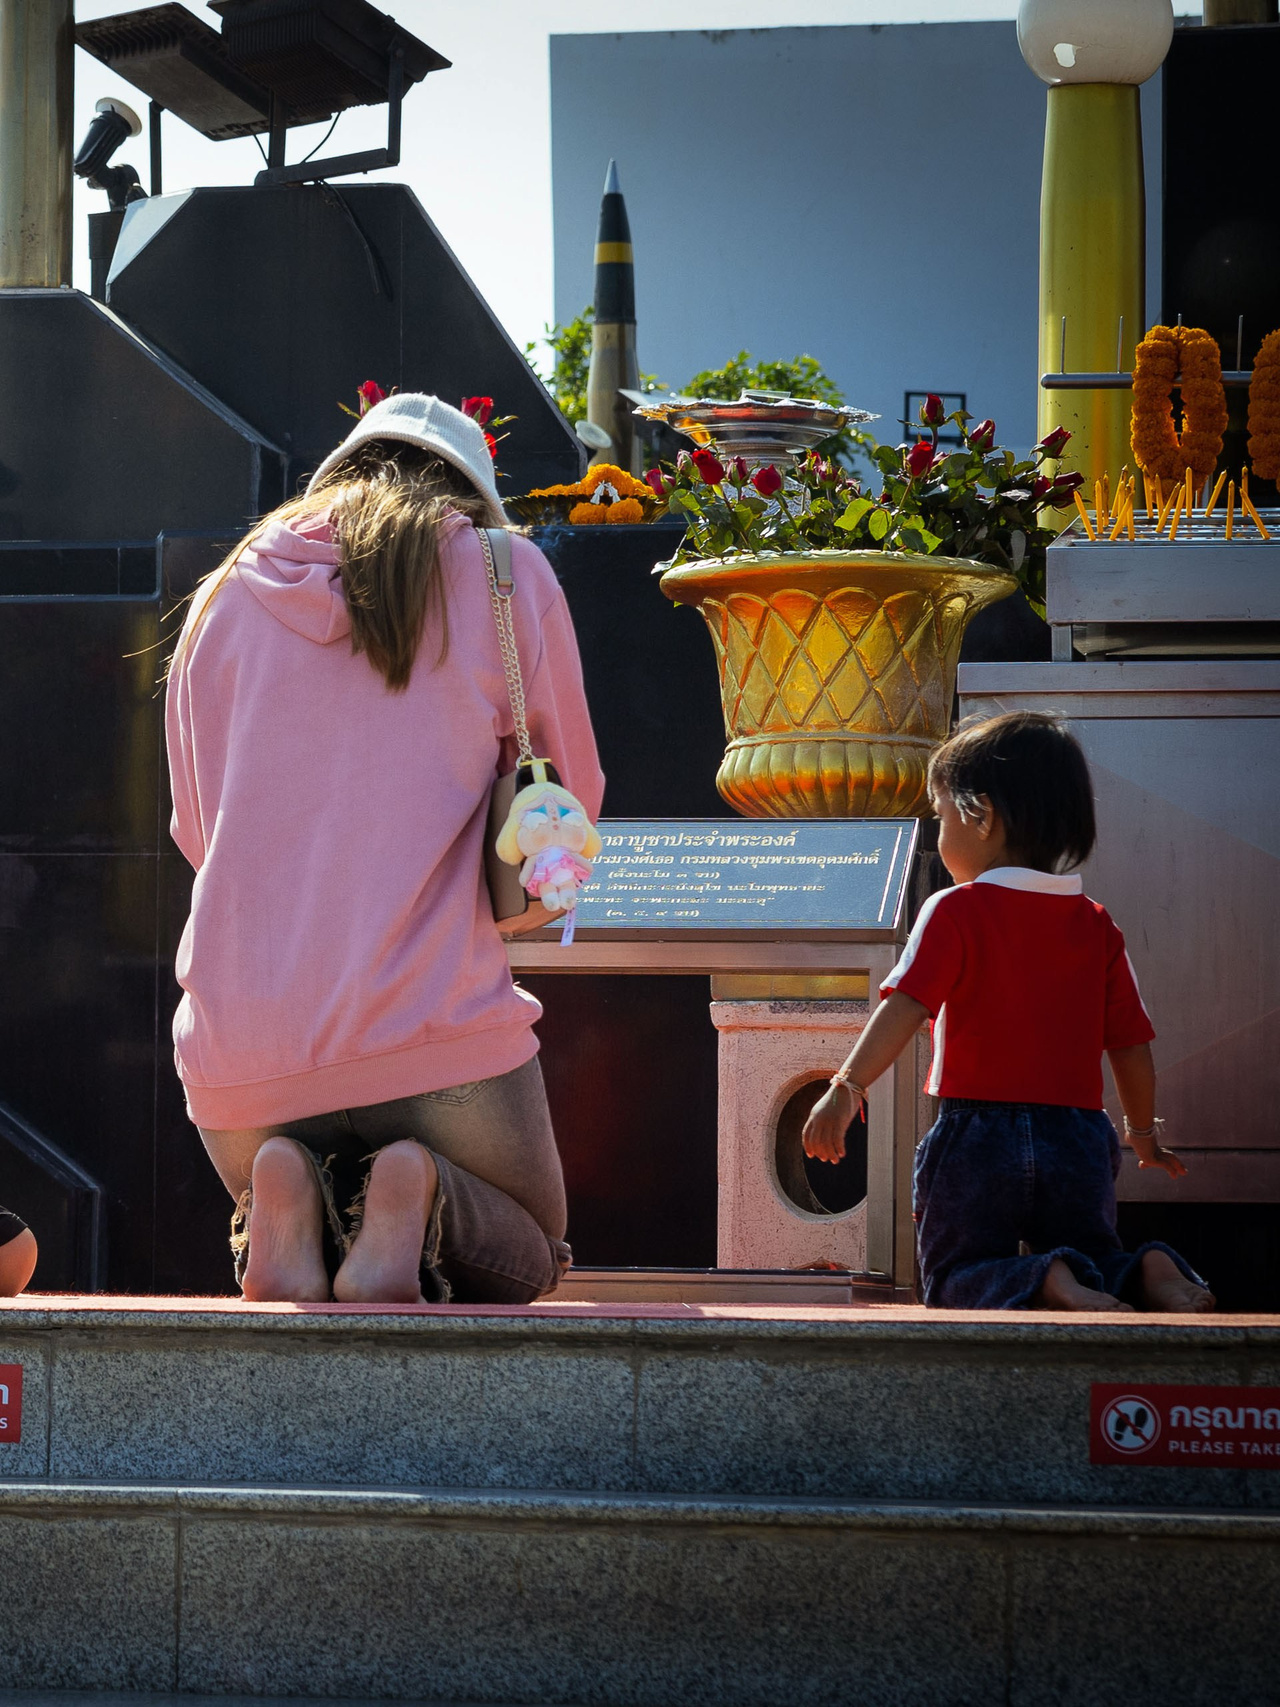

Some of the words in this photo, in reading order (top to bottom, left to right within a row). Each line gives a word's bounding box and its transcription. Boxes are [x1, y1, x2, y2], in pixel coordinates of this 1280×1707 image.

[601, 830, 800, 853] าถาบูชาประจำพระองค์
[588, 851, 675, 864] บรมวงศ์เธอ
[1169, 1405, 1280, 1438] กรุณาถ
[1168, 1440, 1235, 1455] PLEASE
